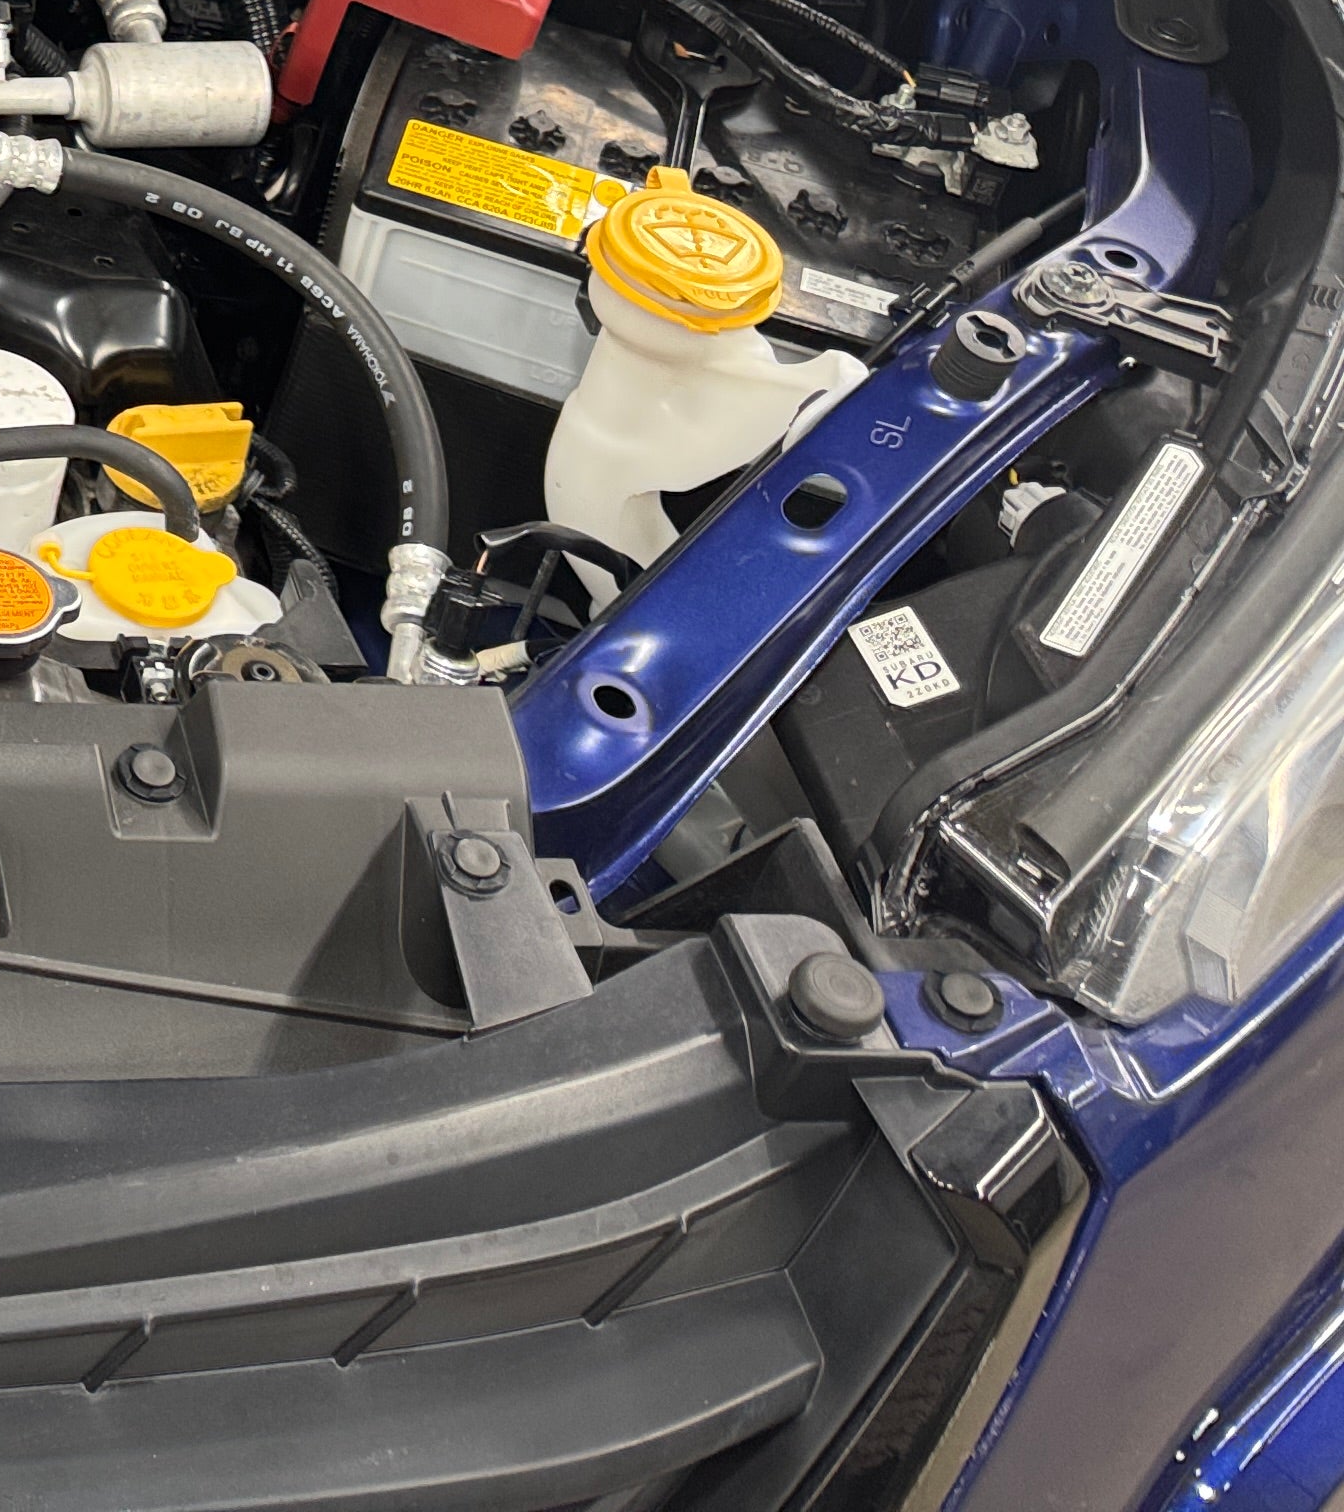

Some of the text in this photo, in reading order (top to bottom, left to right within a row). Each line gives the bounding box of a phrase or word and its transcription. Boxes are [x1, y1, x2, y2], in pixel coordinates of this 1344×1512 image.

[411, 122, 464, 143] DANGER
[401, 153, 452, 173] POISON
[144, 191, 160, 204] 2
[456, 194, 481, 208] CCA
[214, 219, 242, 238] BJ
[245, 238, 272, 259] HP
[347, 324, 391, 387] YOKOHAMA
[869, 414, 912, 450] SL
[882, 650, 936, 676] SUBARU
[885, 661, 943, 692] KD
